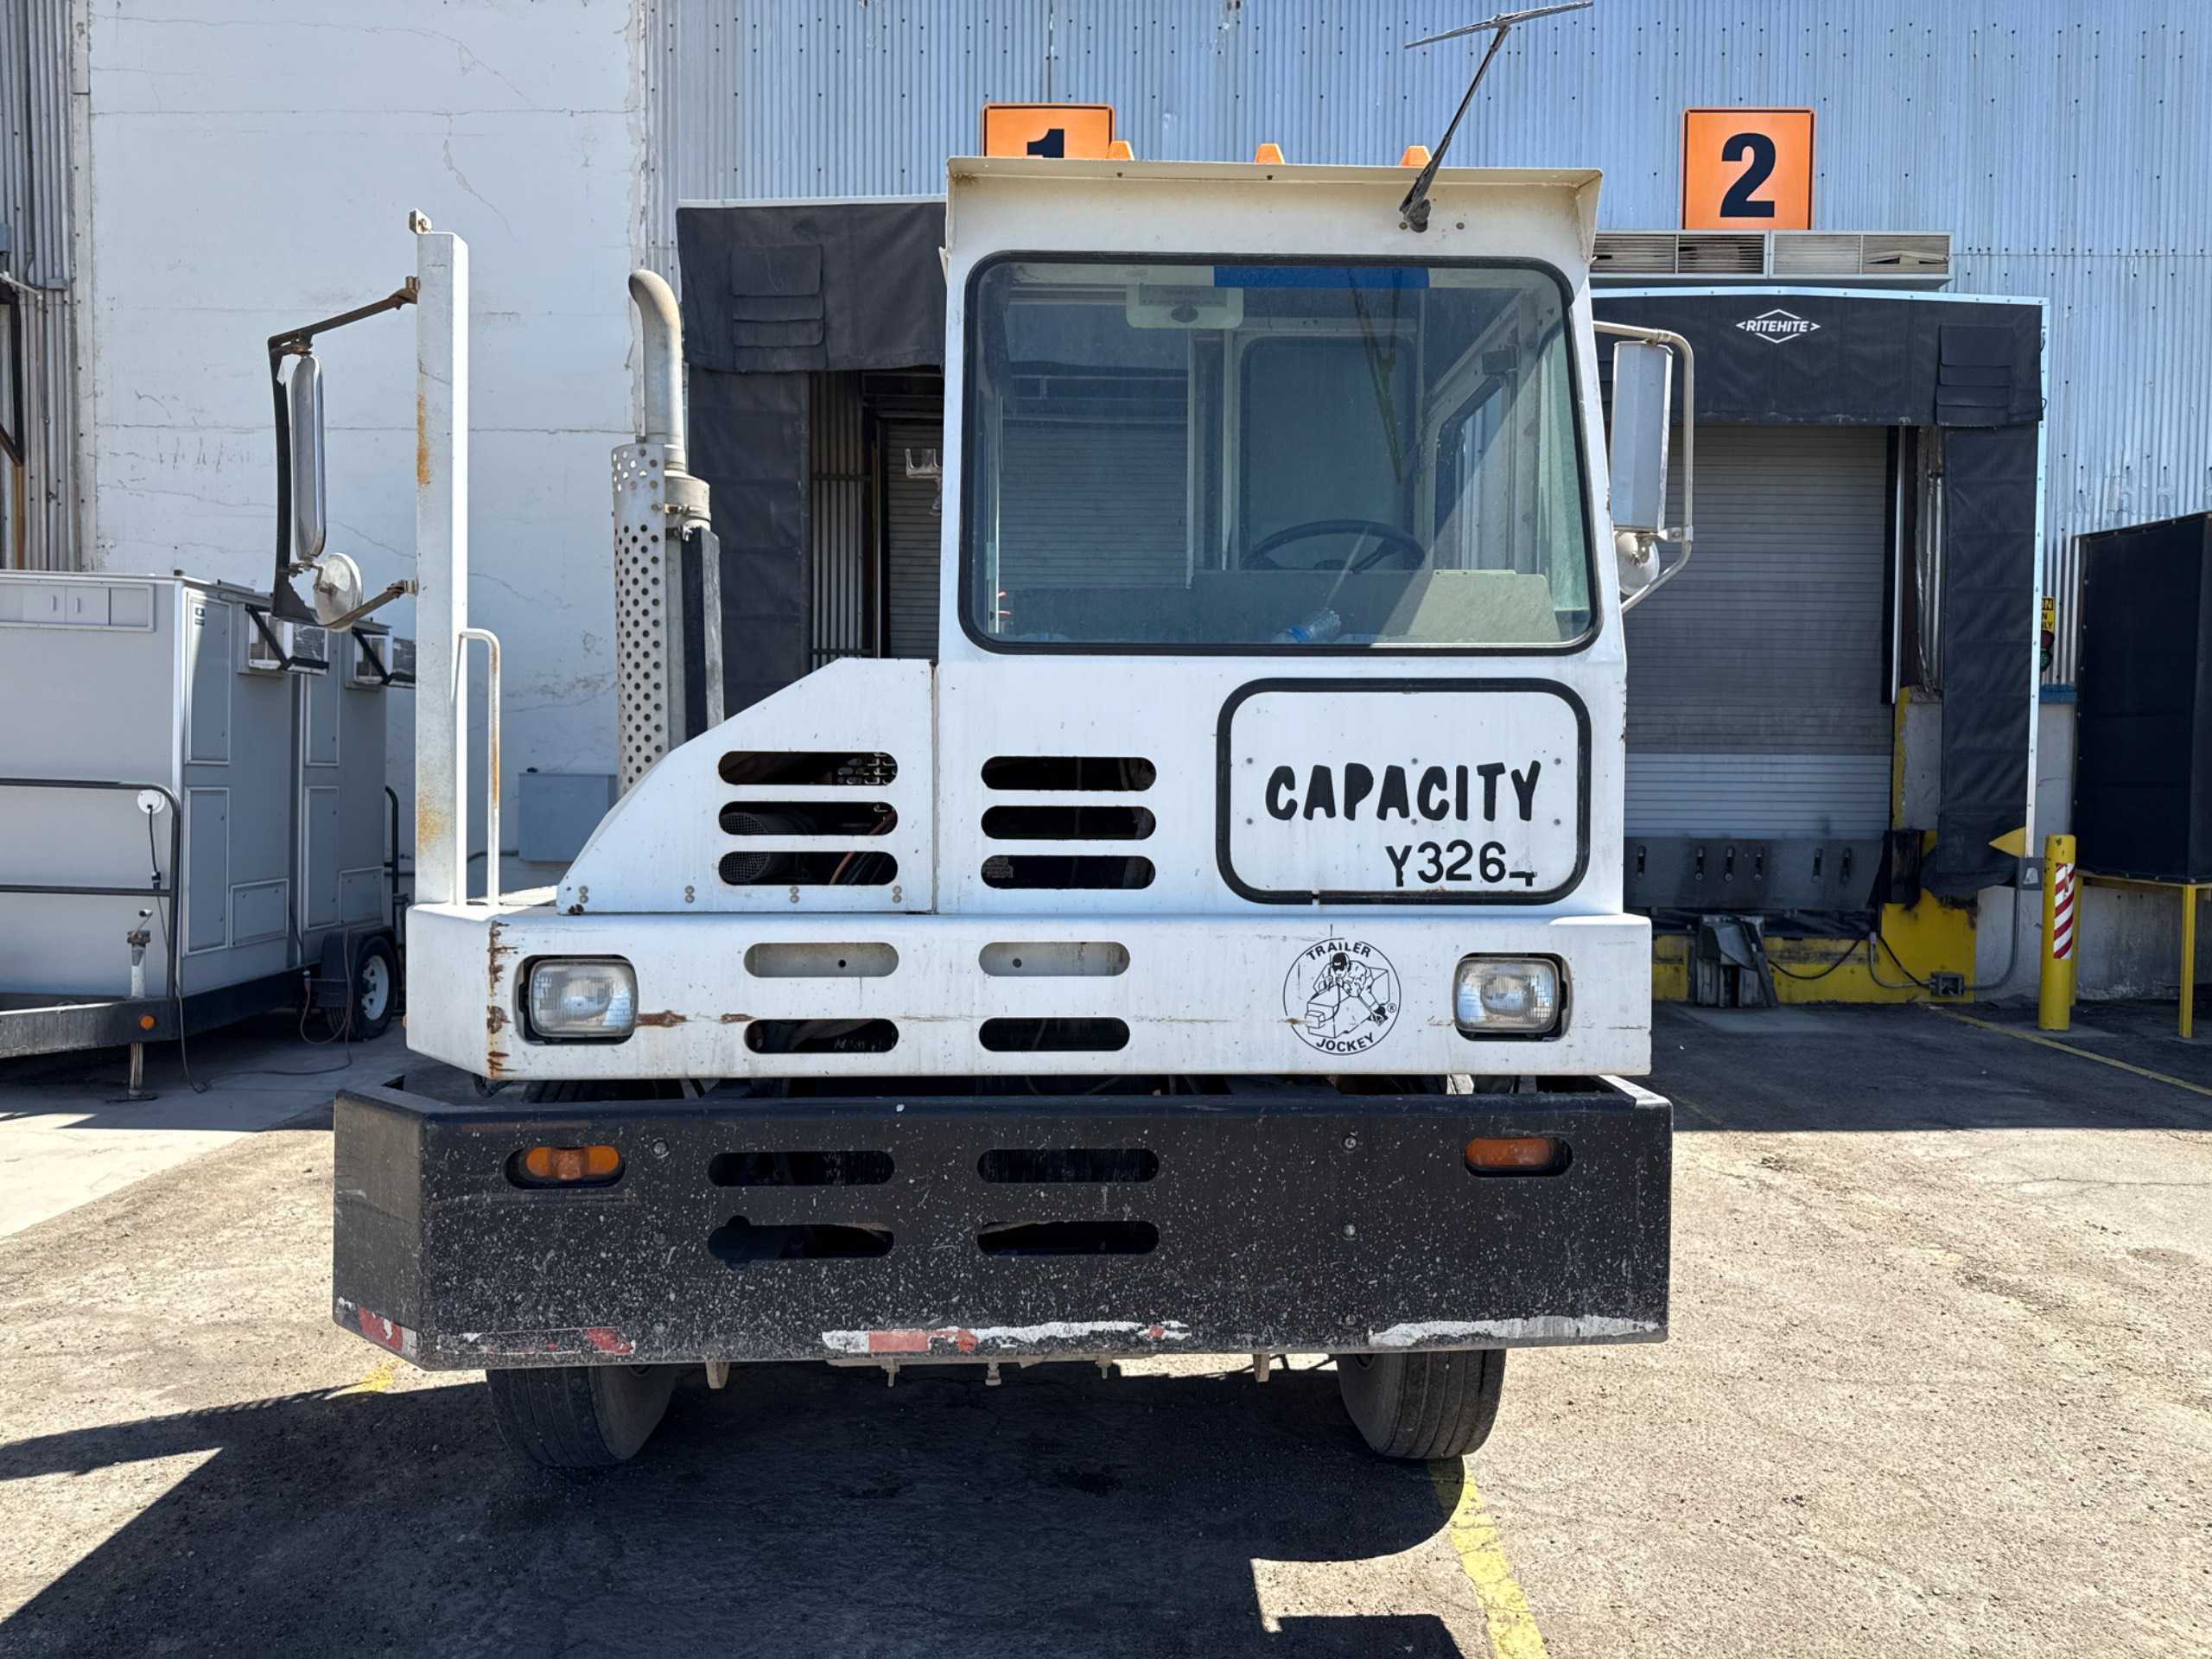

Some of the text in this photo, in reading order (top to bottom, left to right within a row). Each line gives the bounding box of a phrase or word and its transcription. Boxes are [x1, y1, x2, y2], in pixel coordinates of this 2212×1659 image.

[1719, 132, 1777, 218] 2
[1745, 320, 1809, 333] RITEHITE
[1265, 760, 1541, 822] CAPACITY
[1306, 942, 1372, 961] TRAILER
[1316, 1032, 1375, 1052] JOCKEY
